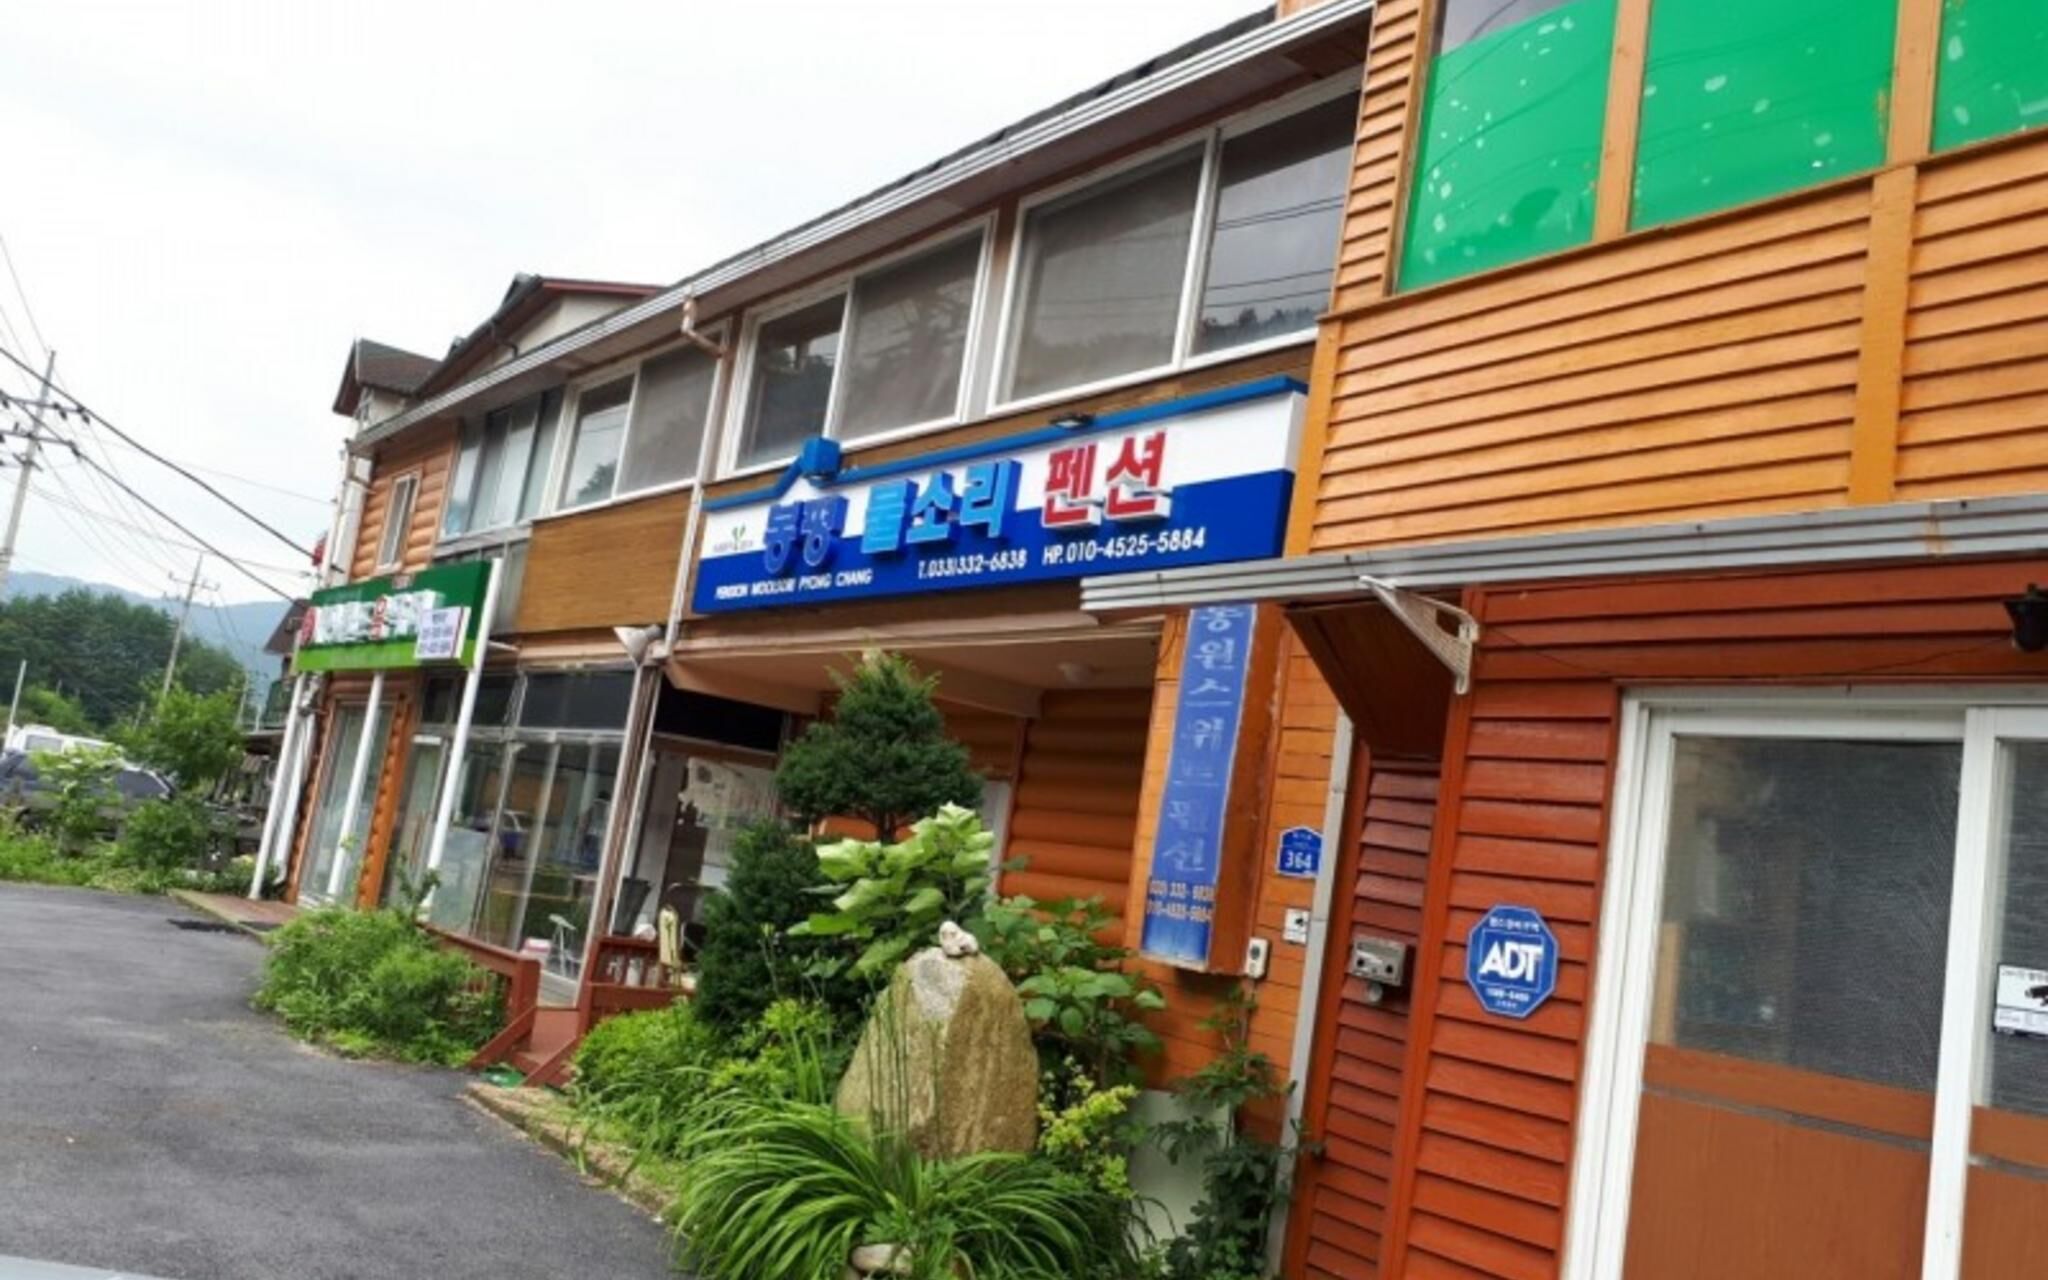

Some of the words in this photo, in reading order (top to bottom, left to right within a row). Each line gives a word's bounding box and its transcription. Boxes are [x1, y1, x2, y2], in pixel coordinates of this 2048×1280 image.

[861, 458, 1020, 554] 물소리
[1042, 429, 1170, 528] 펜션
[835, 567, 873, 588] CHANG
[1479, 940, 1544, 982] ADT
